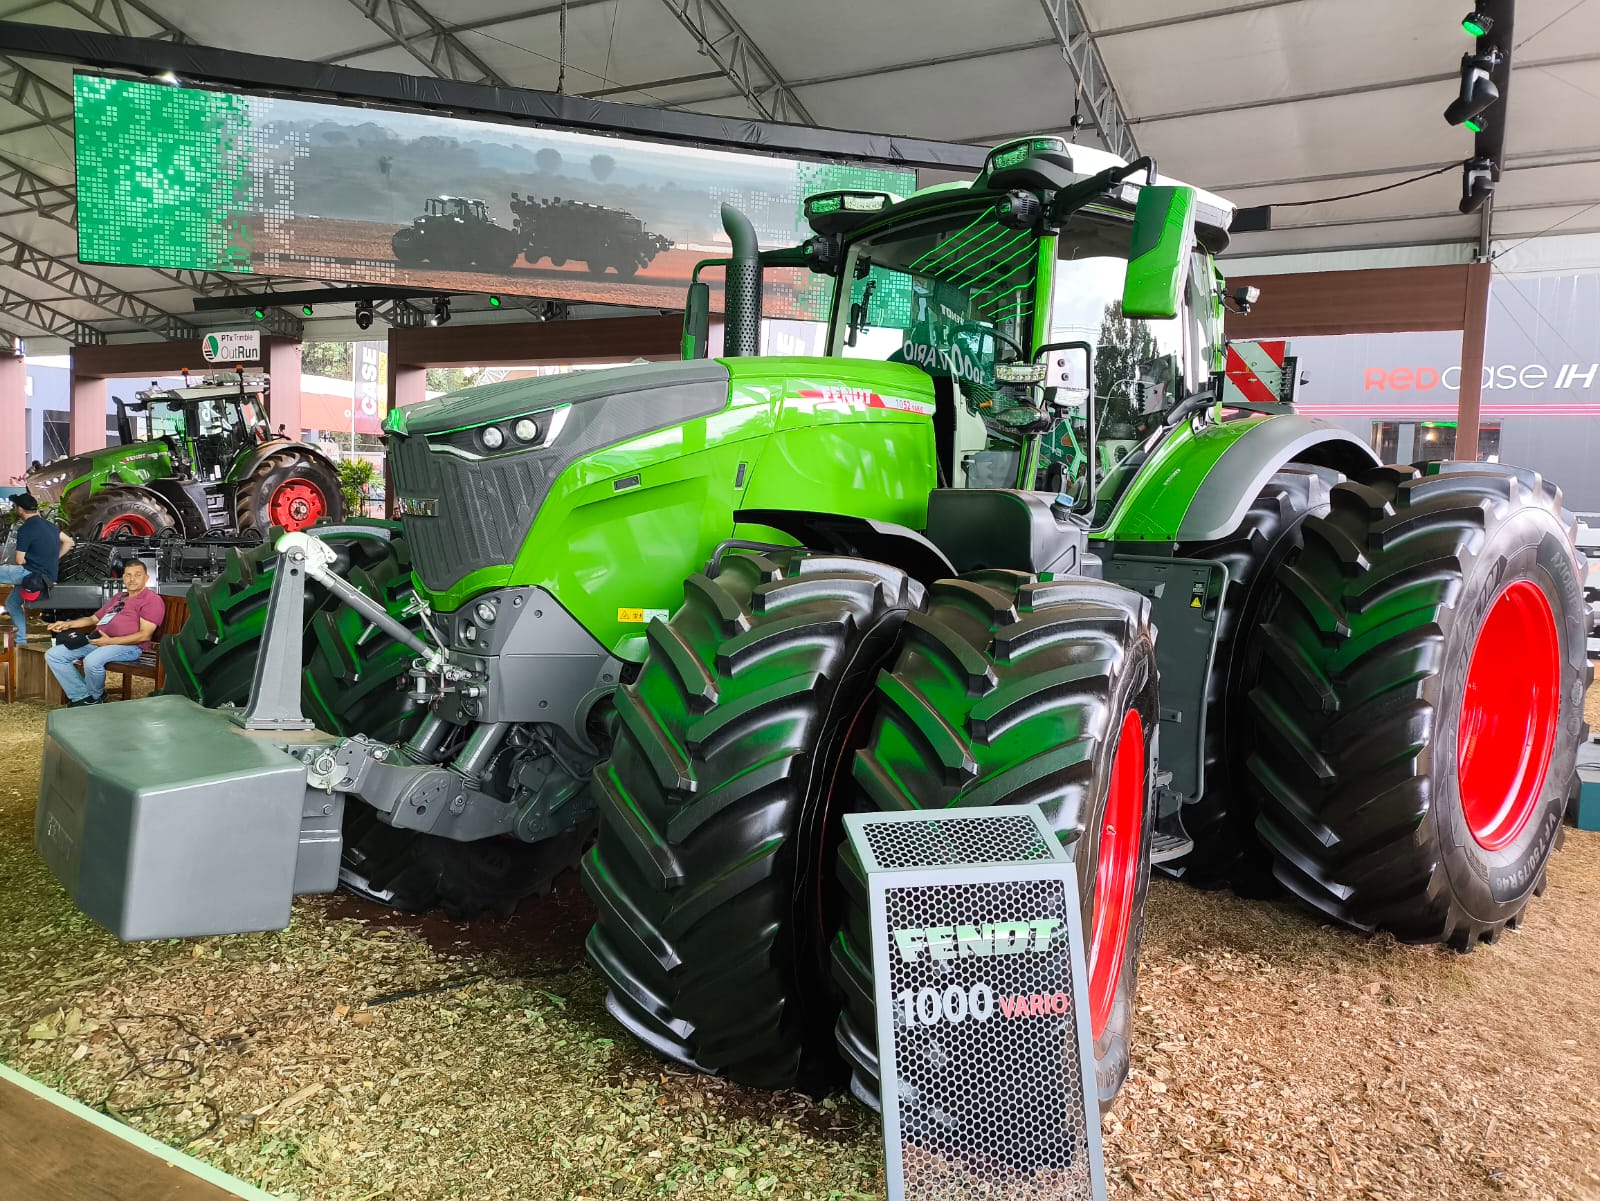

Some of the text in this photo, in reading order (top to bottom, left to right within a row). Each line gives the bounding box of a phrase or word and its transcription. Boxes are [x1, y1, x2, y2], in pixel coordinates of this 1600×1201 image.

[221, 345, 258, 360] OutRun
[361, 346, 377, 416] CASE
[1553, 363, 1600, 389] IH
[895, 398, 911, 411] 1052
[893, 918, 1062, 963] FENDT
[898, 982, 1069, 1028] 1000 VARIO
